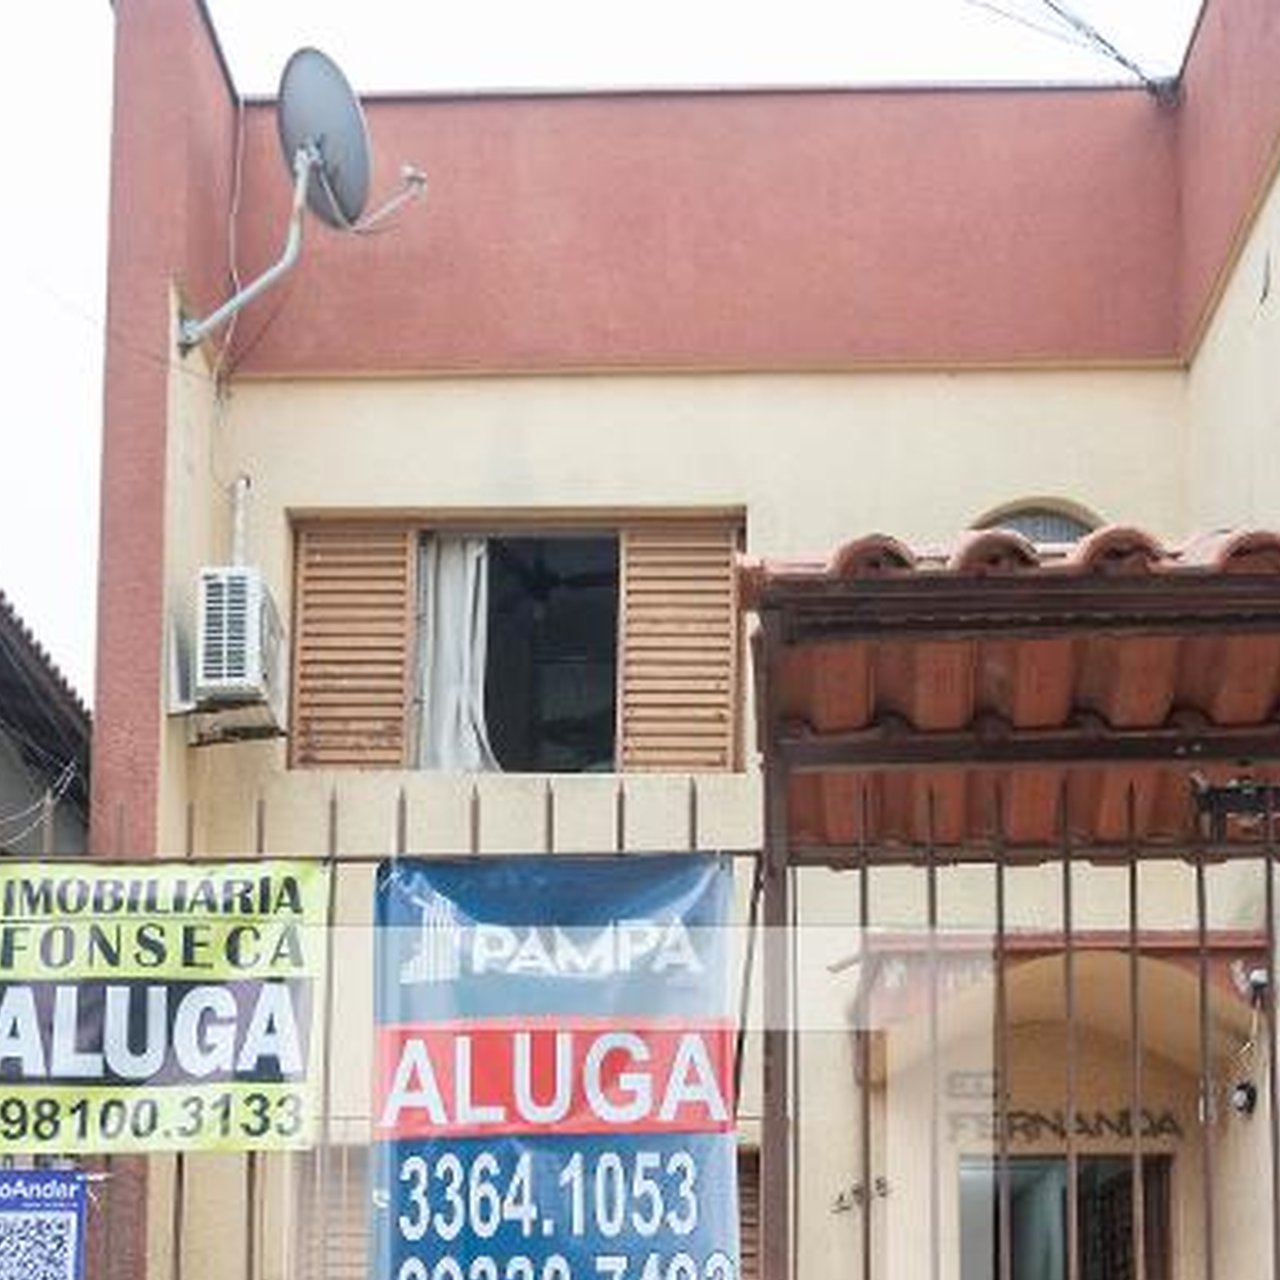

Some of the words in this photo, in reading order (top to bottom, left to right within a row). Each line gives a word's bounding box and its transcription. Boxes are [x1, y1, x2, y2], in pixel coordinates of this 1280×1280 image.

[2, 868, 304, 916] IMOBILIÁRIA
[0, 922, 305, 969] FONSECA
[470, 914, 704, 978] PAMPA
[380, 1032, 730, 1129] ALUGA
[1, 1091, 303, 1140] 98100.3133
[398, 1150, 700, 1242] 3364.1053
